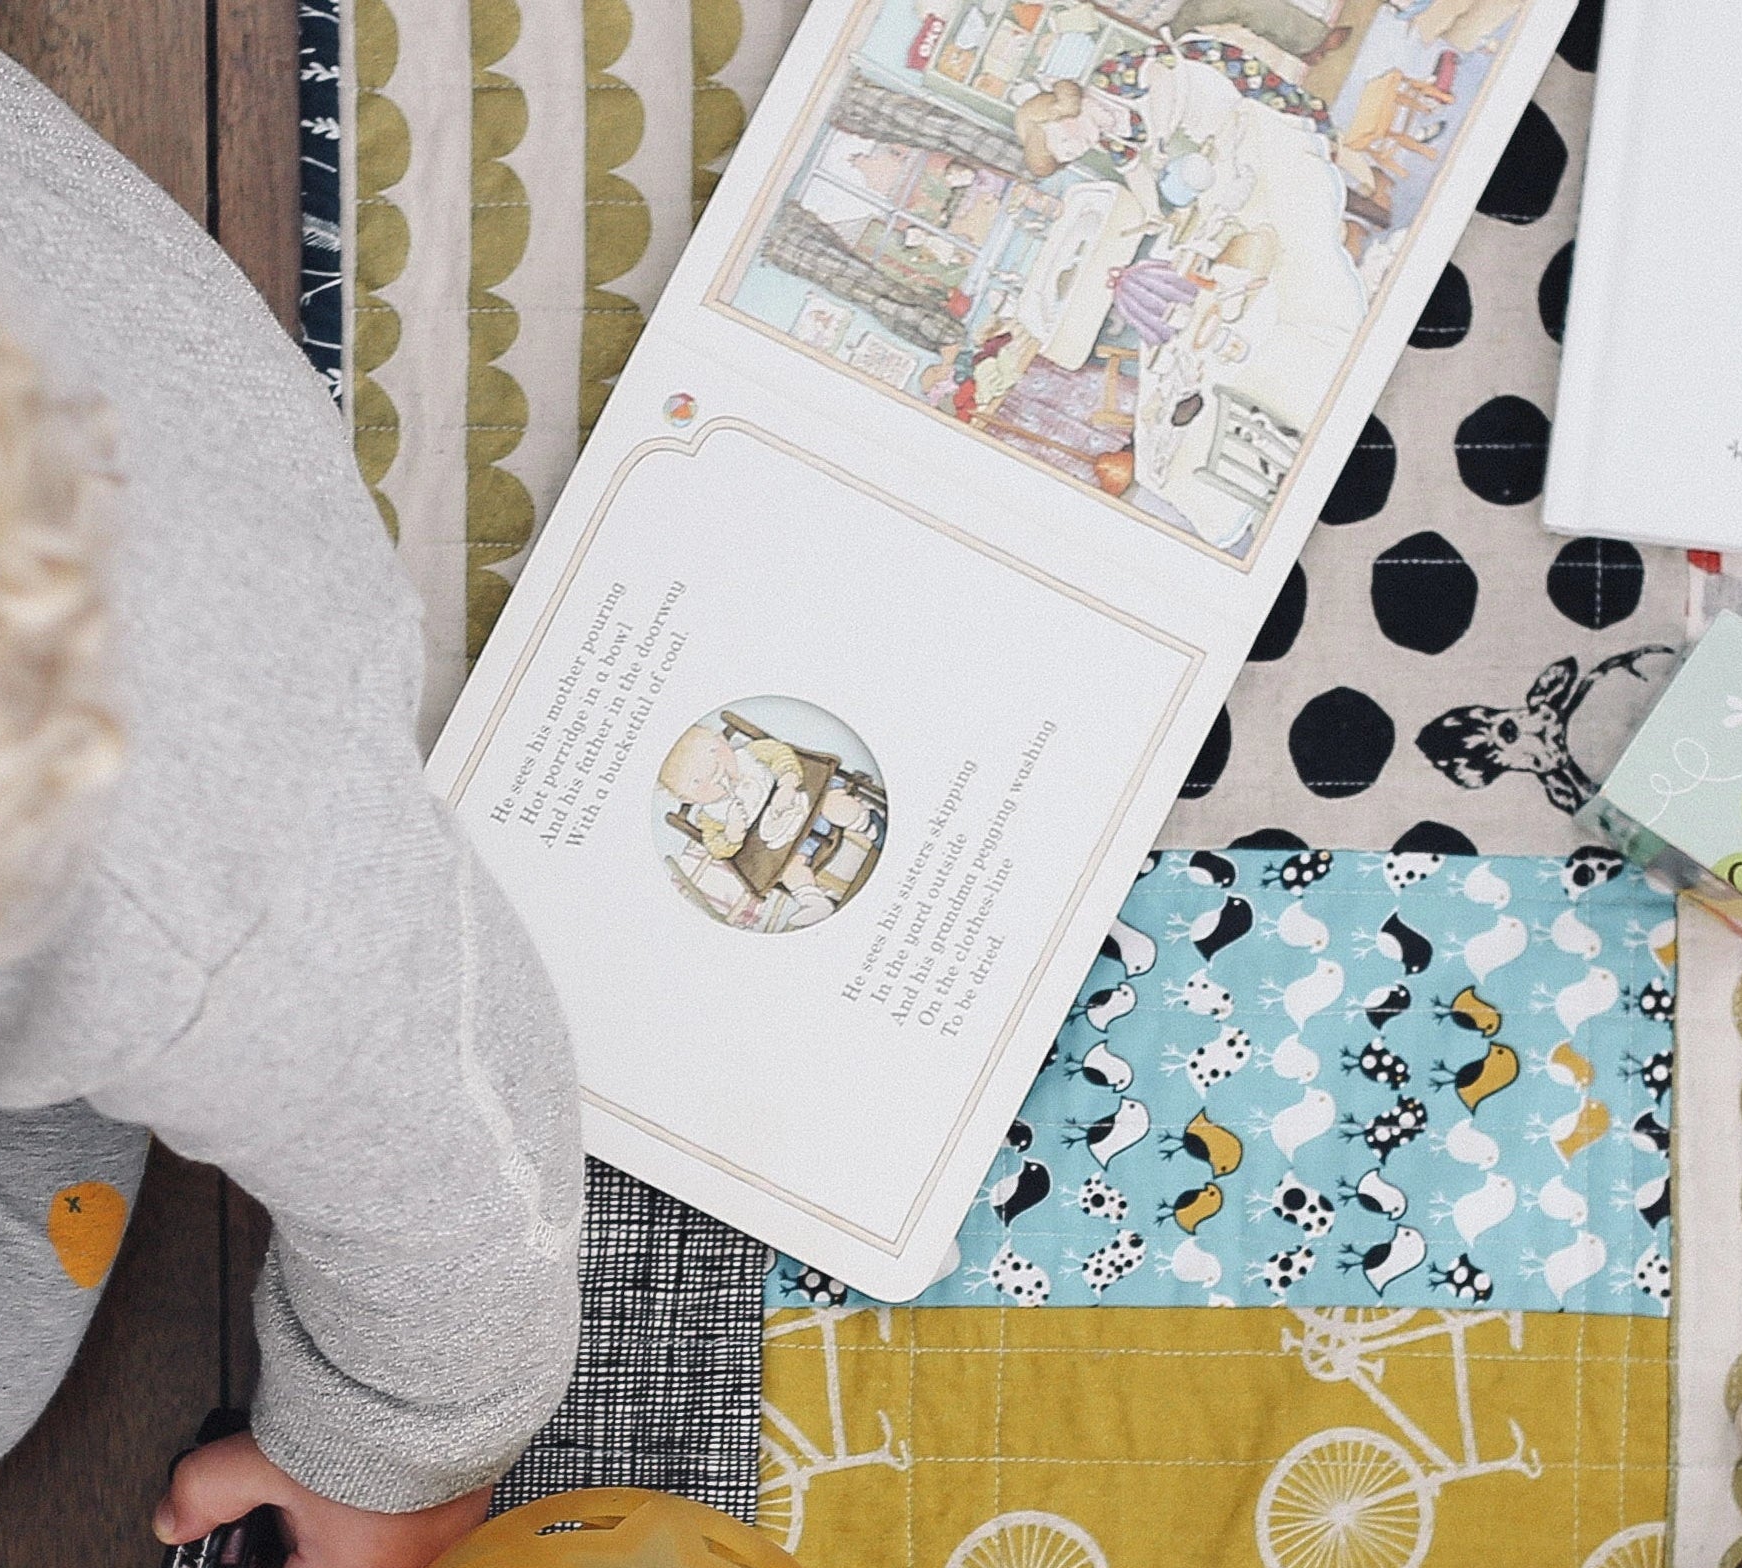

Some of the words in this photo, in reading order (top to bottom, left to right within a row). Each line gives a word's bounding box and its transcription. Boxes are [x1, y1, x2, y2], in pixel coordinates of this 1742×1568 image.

[595, 670, 610, 684] a
[598, 621, 634, 667] bowl
[649, 670, 666, 695] of
[660, 629, 689, 673] coal.
[489, 797, 515, 824] He
[511, 756, 536, 795] sees
[525, 725, 552, 753] his
[546, 655, 586, 722] mother
[580, 581, 627, 655] pouring
[539, 807, 569, 849] And
[557, 778, 584, 807] his
[574, 717, 614, 775] father
[608, 696, 627, 716] in
[618, 661, 642, 692] the
[634, 580, 687, 659] doorway
[583, 687, 602, 707] in
[542, 709, 588, 789] porridge
[597, 695, 655, 785] bucketful
[518, 790, 548, 826] Hot
[564, 804, 601, 846] With
[595, 787, 610, 801] a
[840, 975, 866, 1002] He
[862, 935, 887, 973] sees
[876, 902, 903, 932] his
[898, 840, 935, 900] sisters
[928, 759, 979, 838] skipping
[890, 985, 920, 1027] And
[908, 956, 935, 985] his
[930, 872, 978, 955] grandma
[971, 798, 1018, 872] pegging
[1009, 719, 1058, 793] washing
[869, 983, 893, 1004] In
[884, 949, 909, 980] the
[903, 900, 933, 947] yard
[927, 832, 968, 900] outside
[917, 1000, 943, 1027] On
[935, 965, 959, 996] the
[954, 857, 1014, 963] clothes-line
[939, 1014, 964, 1037] To
[953, 988, 977, 1011] be
[969, 932, 1006, 986] dried.
